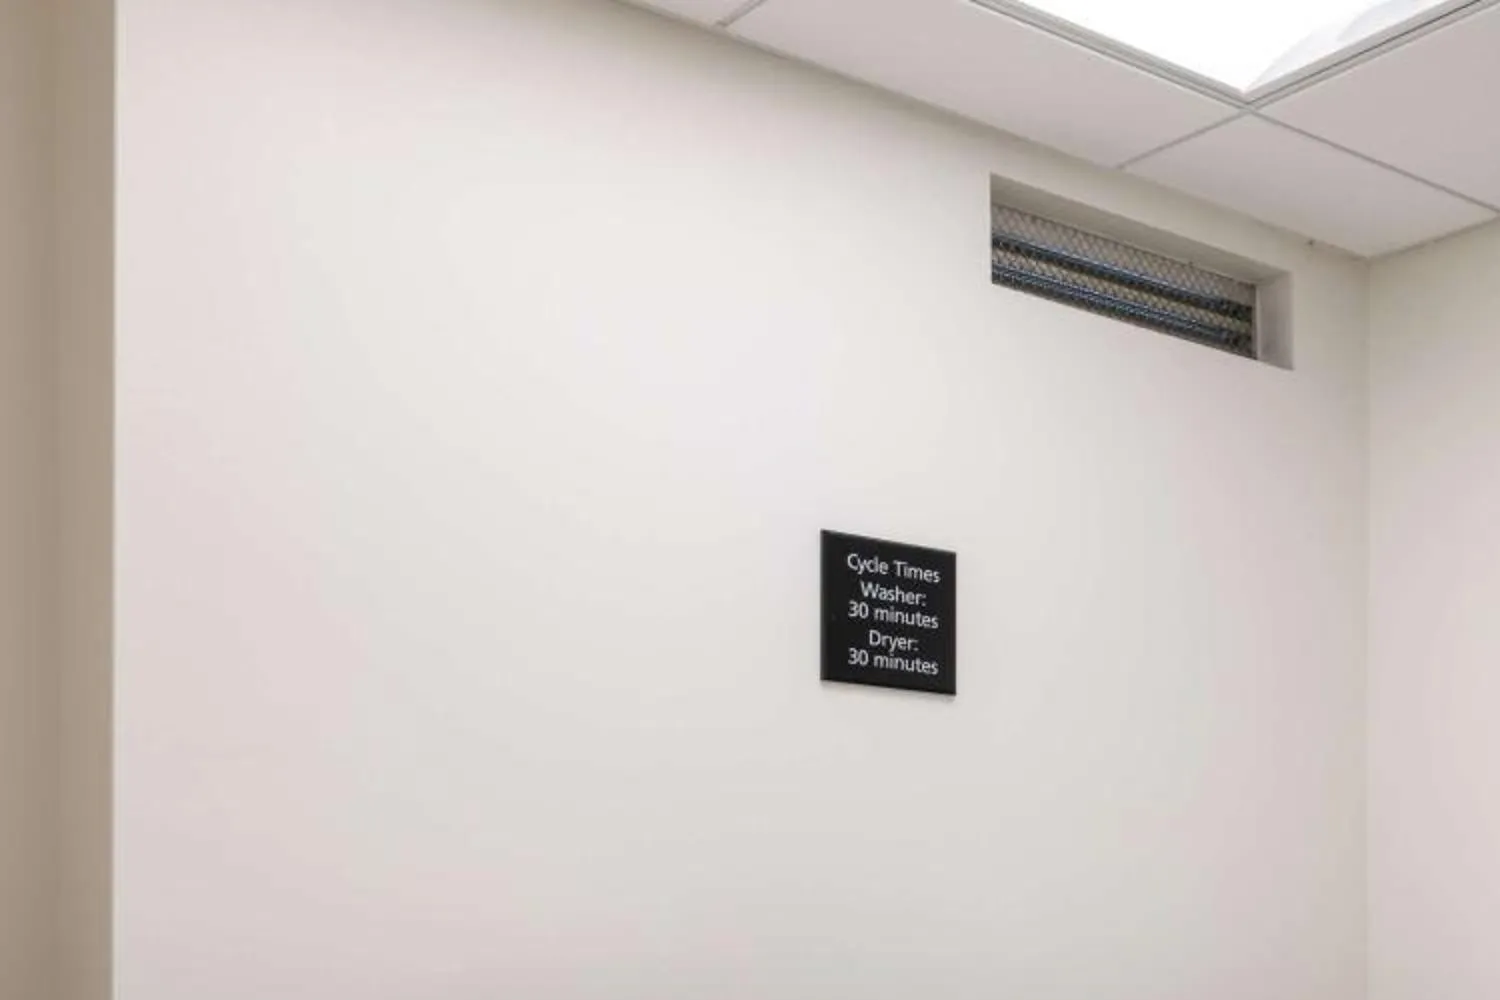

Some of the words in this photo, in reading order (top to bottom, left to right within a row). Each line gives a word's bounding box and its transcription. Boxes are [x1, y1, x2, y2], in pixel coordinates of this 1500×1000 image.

[847, 553, 889, 575] Cycle
[893, 560, 941, 583] Times
[860, 580, 927, 607] Washer:
[848, 601, 869, 619] 30
[874, 606, 939, 629] minutes
[869, 630, 919, 656] Dryer:
[848, 648, 869, 666] 30
[874, 652, 939, 675] minutes
